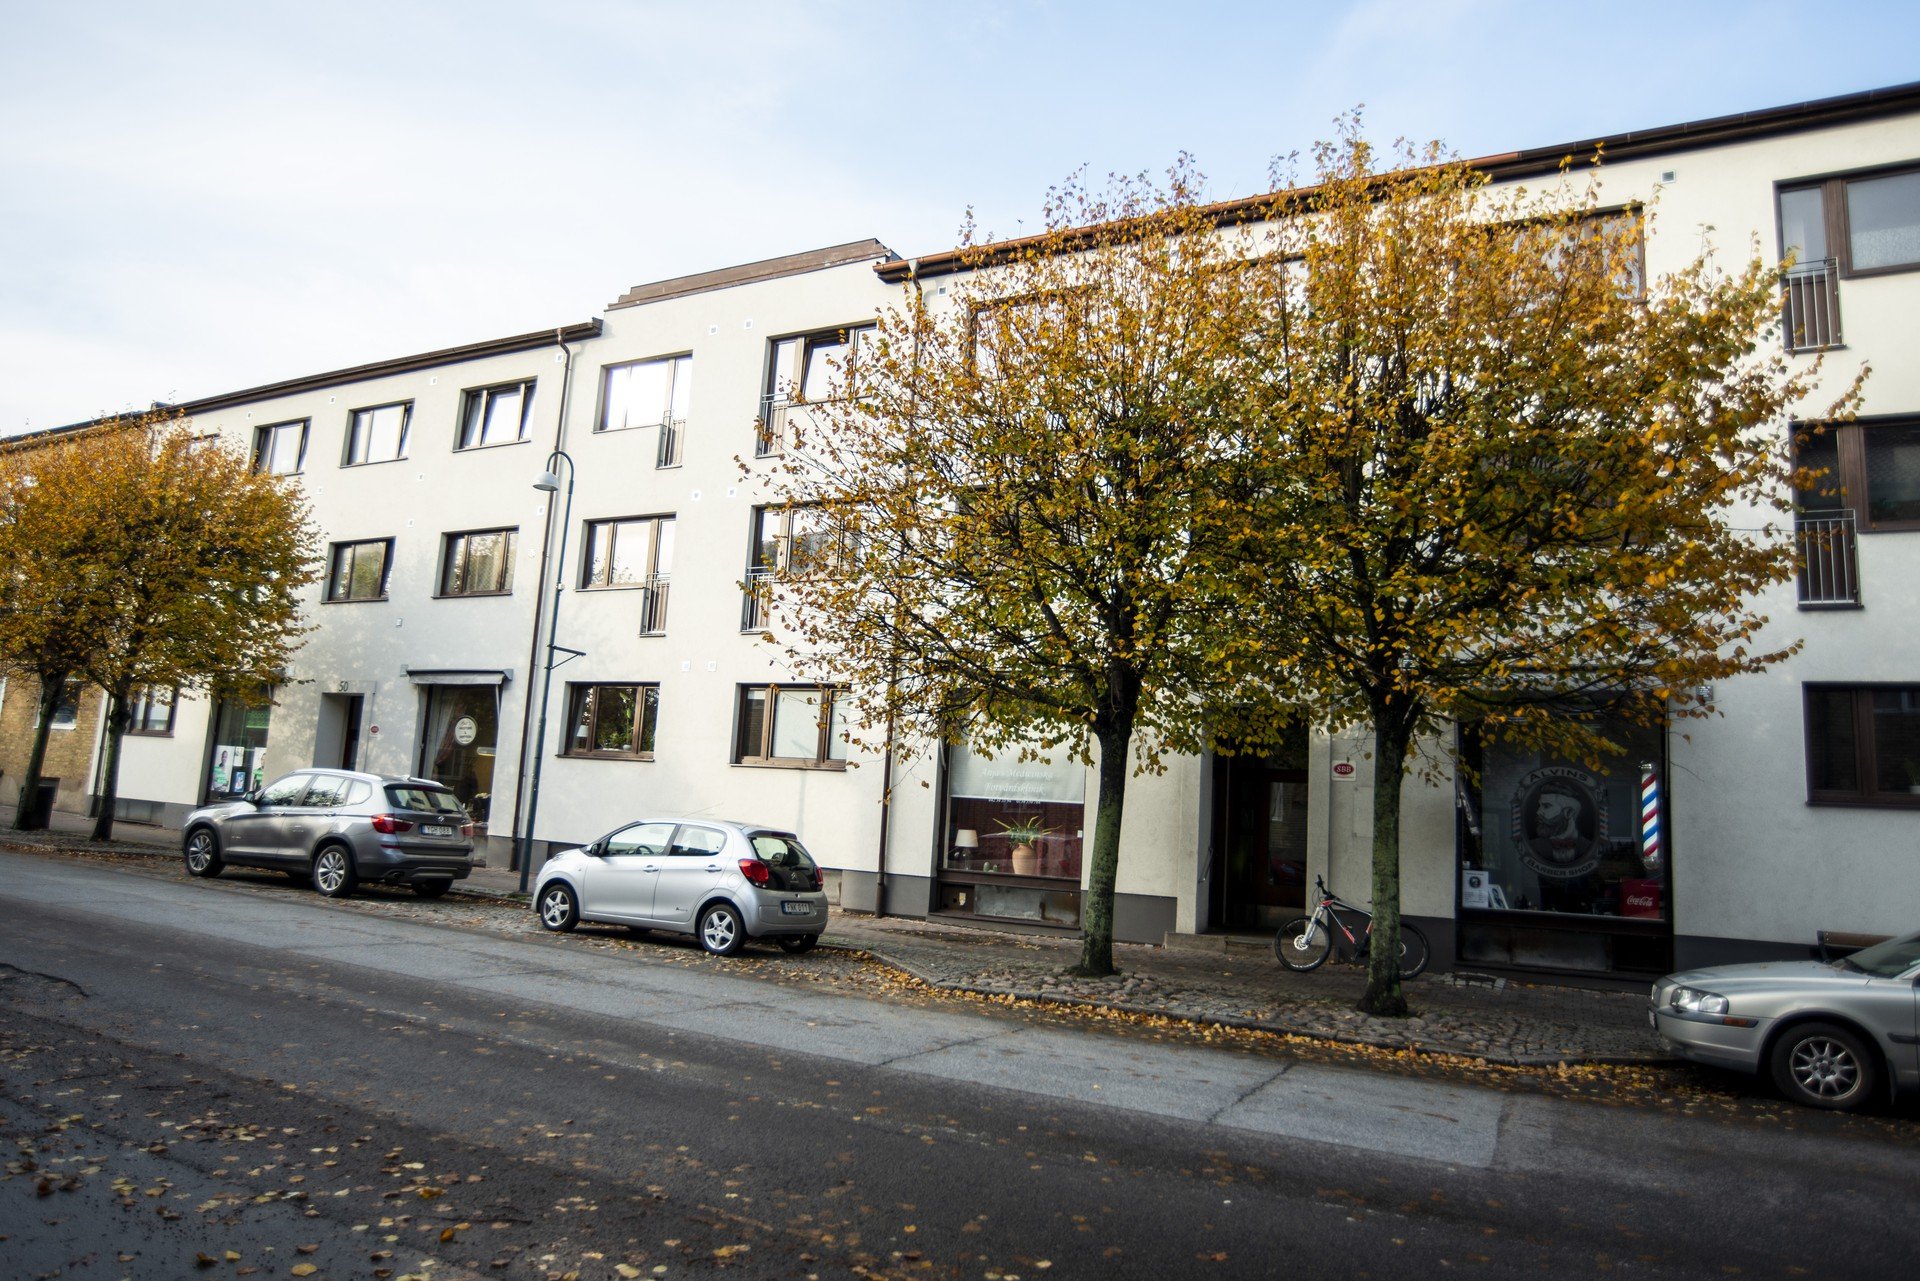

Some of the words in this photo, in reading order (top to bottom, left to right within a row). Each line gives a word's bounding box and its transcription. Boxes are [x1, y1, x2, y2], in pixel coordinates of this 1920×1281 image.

[339, 681, 349, 692] 50
[1336, 765, 1352, 773] SBB
[1529, 768, 1588, 782] ALVINS
[1527, 858, 1566, 876] BARBER
[1568, 861, 1594, 876] SHOP
